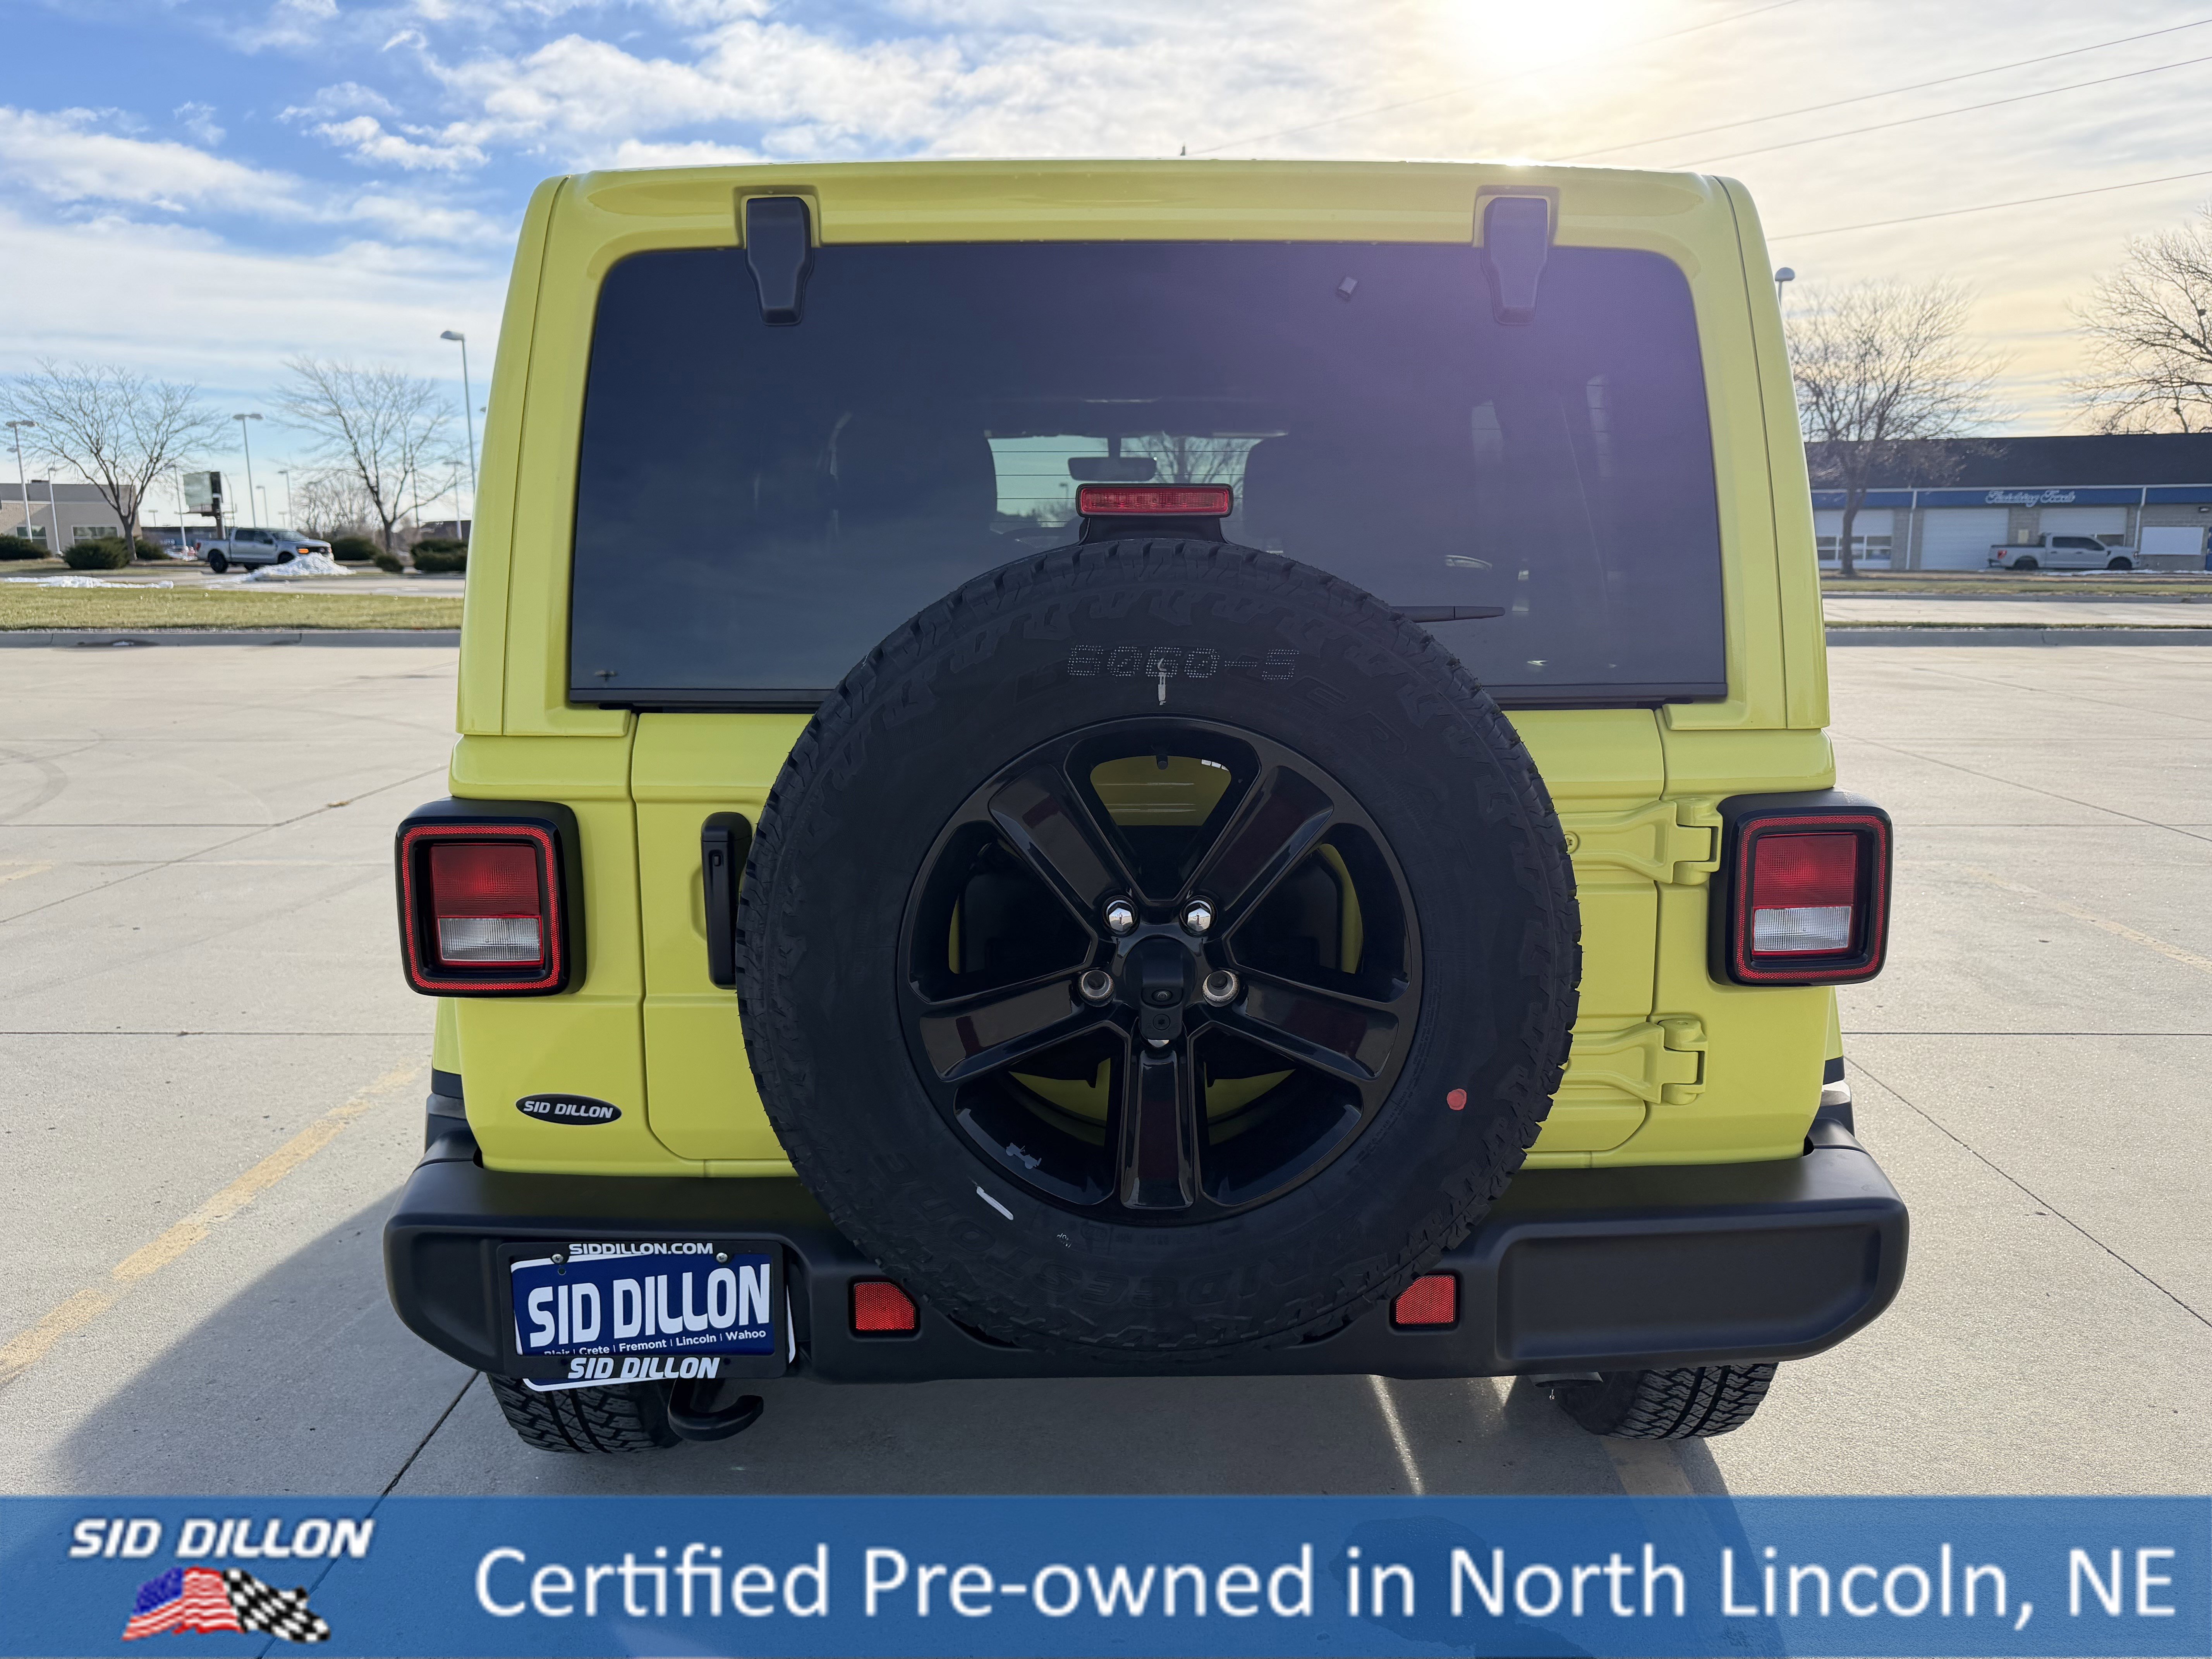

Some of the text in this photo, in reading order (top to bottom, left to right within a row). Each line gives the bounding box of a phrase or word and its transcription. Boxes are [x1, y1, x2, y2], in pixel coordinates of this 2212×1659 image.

[523, 1101, 613, 1118] SID DILLON
[569, 1242, 713, 1255] SIDDILLON.COM
[527, 1263, 770, 1348] SID DILLON
[579, 1345, 610, 1355] Crete
[620, 1339, 667, 1352] Fremont
[676, 1334, 717, 1346] Lincoln
[725, 1329, 767, 1341] Wahoo
[568, 1357, 720, 1379] SID DILLON
